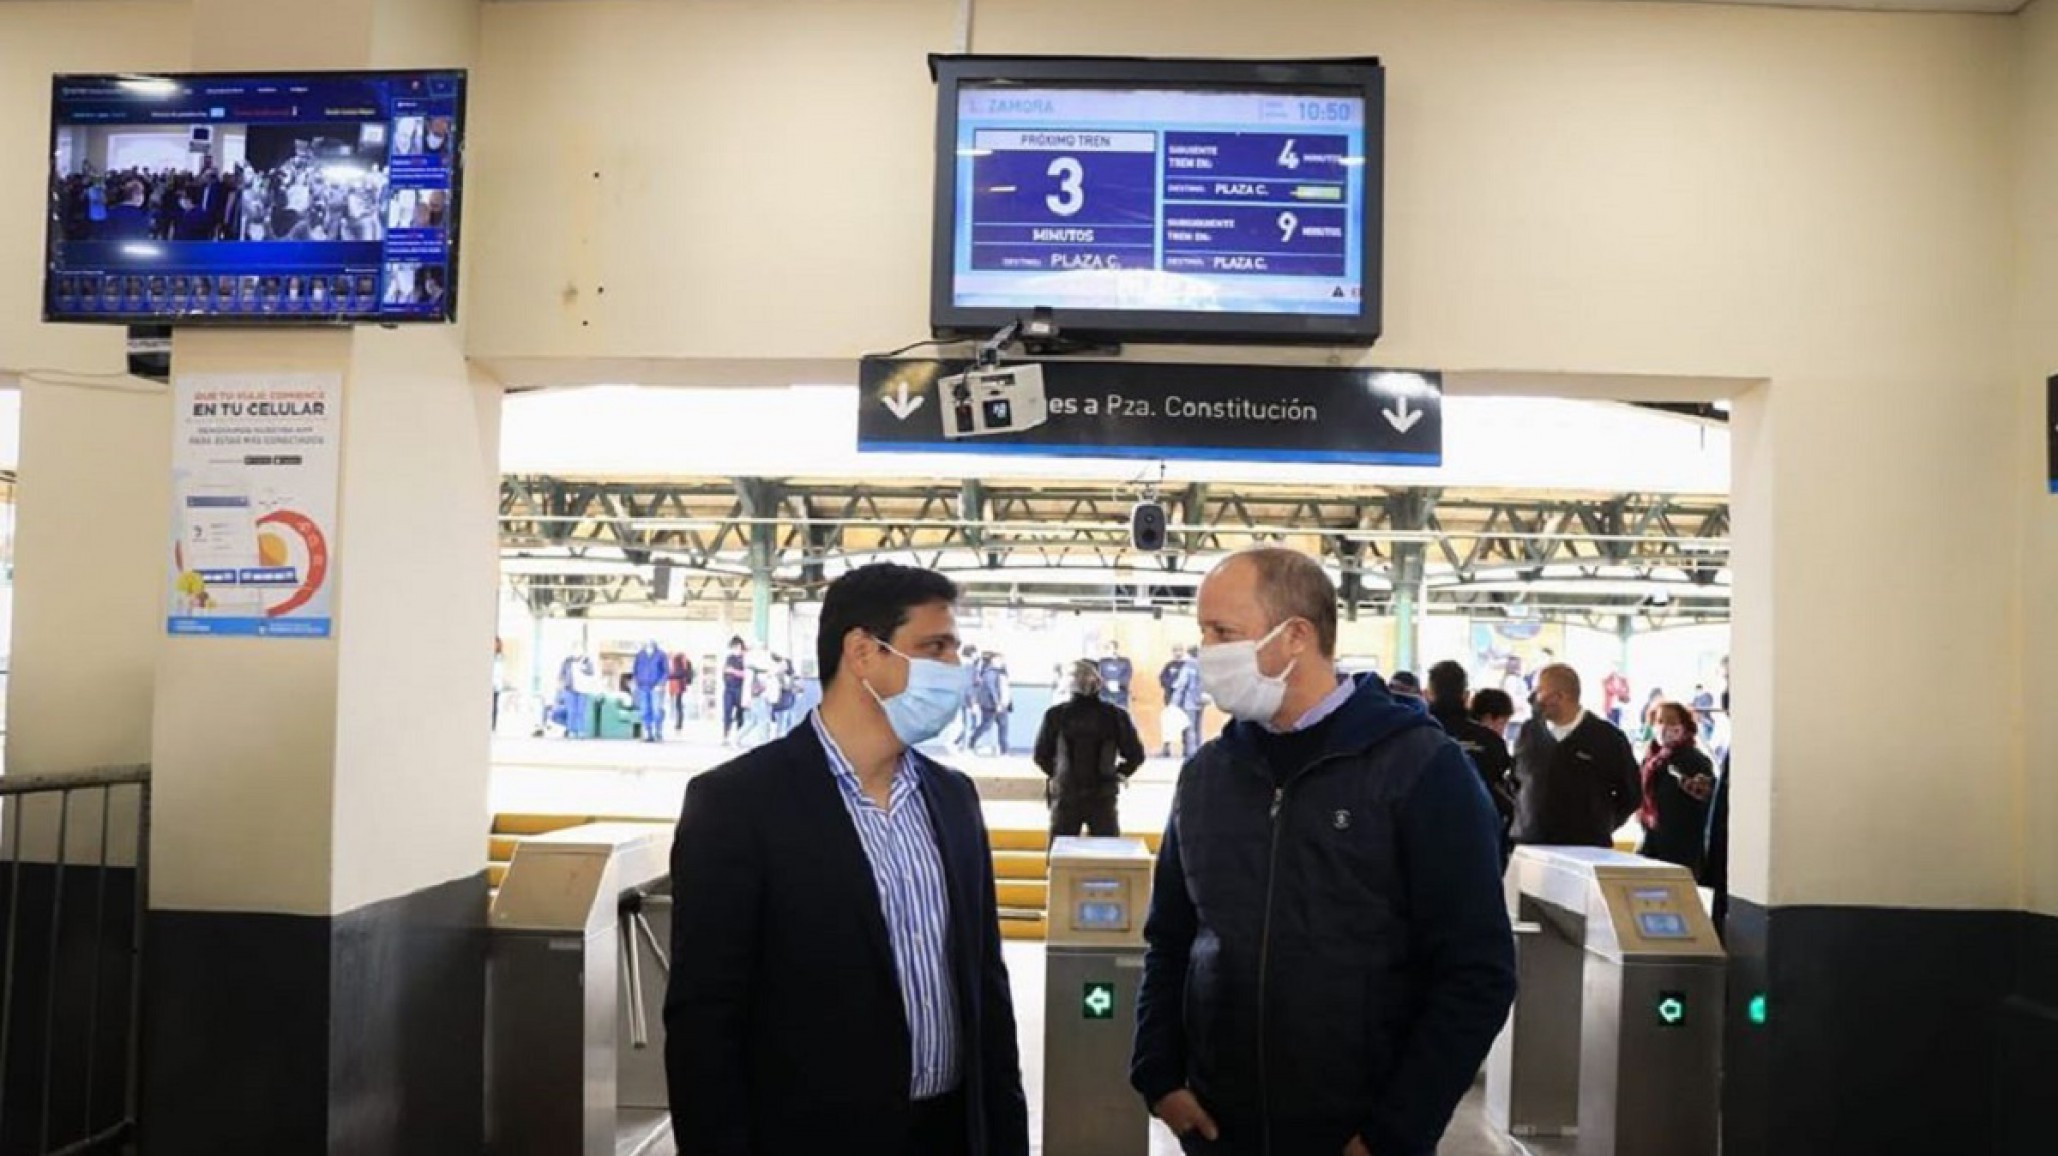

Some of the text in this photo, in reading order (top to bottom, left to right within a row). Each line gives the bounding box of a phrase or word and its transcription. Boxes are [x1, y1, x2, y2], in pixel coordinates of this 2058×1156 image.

[988, 100, 1054, 113] ZAMORA
[1299, 102, 1350, 121] 10:50
[1078, 135, 1111, 147] TREN
[1277, 139, 1300, 169] 4
[1168, 158, 1193, 169] TREN
[1046, 157, 1084, 217] 3
[1215, 183, 1254, 195] PLAZA
[1257, 184, 1269, 196] C.
[1277, 211, 1342, 242] 9 MINUTOS
[1032, 228, 1095, 243] MINUTOS
[1167, 232, 1192, 241] TREN
[1051, 254, 1101, 268] PLAZA
[1107, 255, 1121, 270] C.
[1213, 256, 1252, 269] PLAZA
[1255, 257, 1268, 270] C.
[222, 391, 234, 399] TU
[193, 403, 325, 416] EN TU CELULAR
[1049, 394, 1317, 420] es a Pza. Constitución
